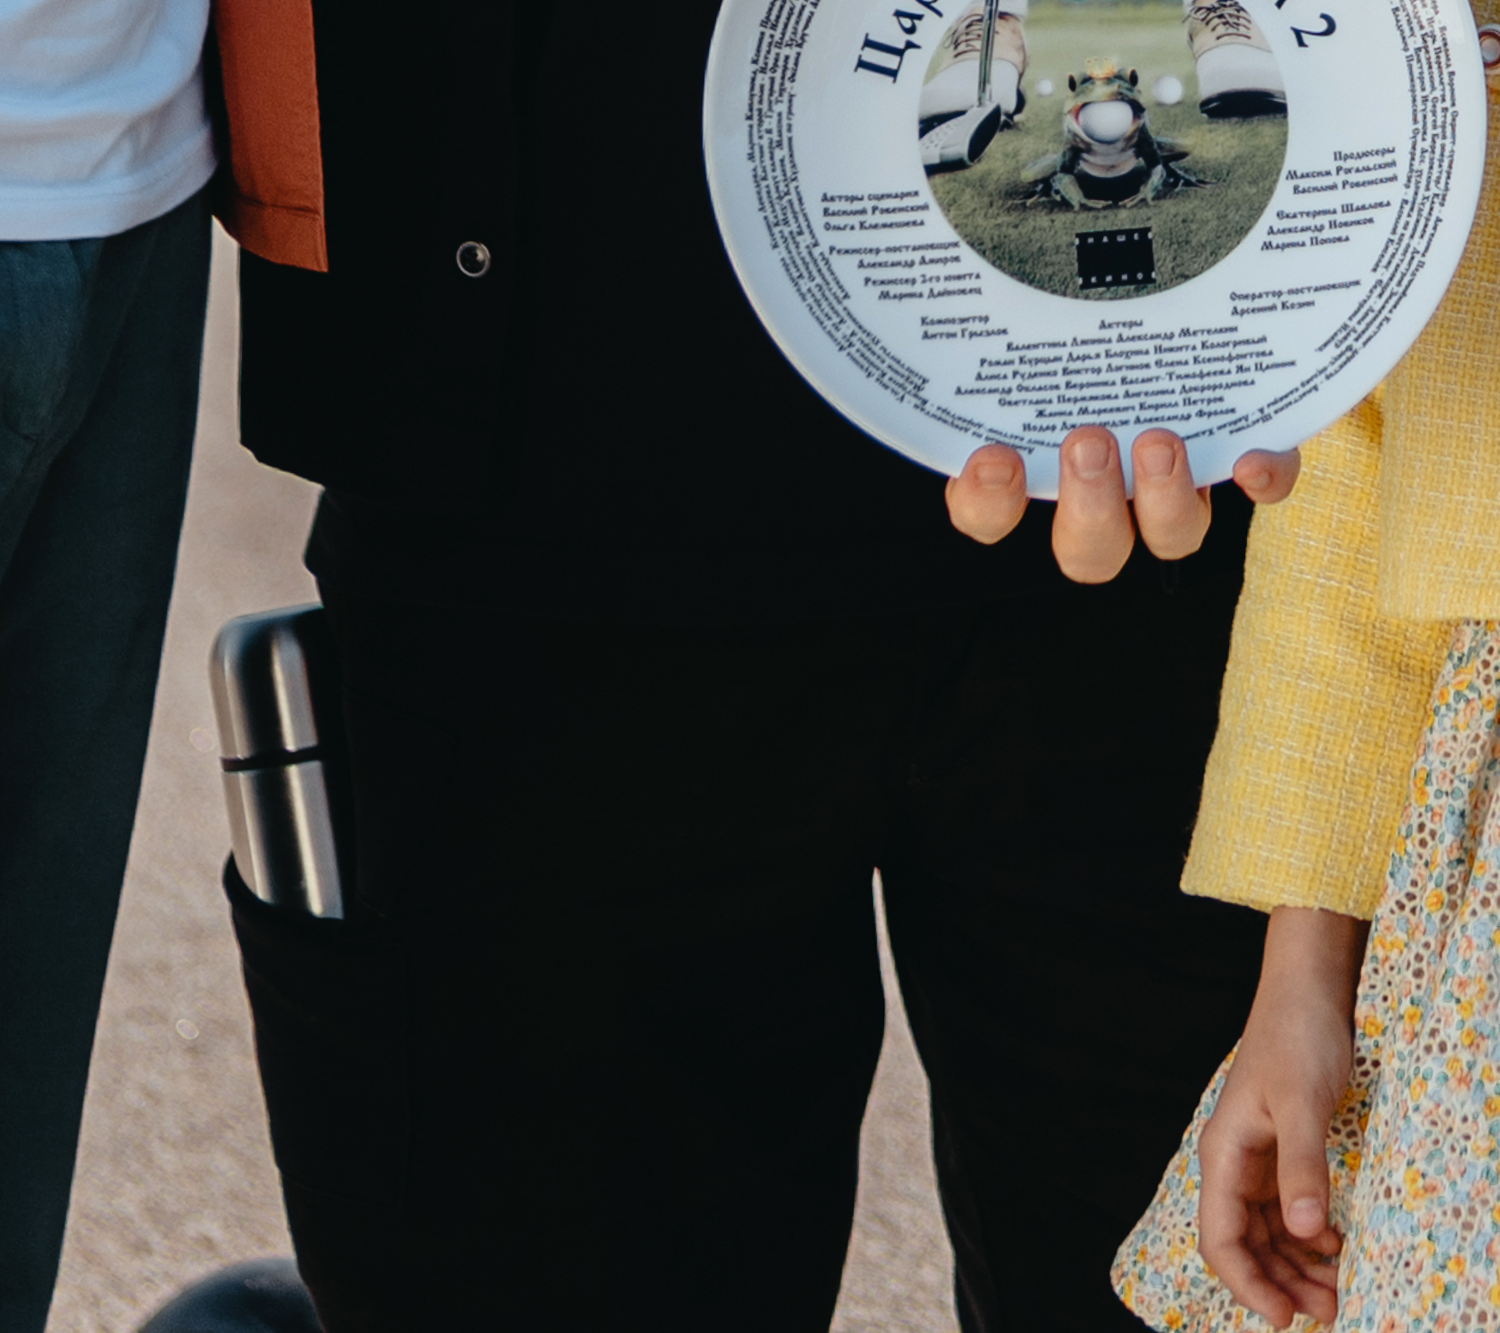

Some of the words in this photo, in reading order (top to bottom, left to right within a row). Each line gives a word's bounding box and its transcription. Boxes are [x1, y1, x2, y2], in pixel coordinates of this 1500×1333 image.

[1290, 13, 1337, 48] 2
[1334, 147, 1395, 162] Продюсеры
[1286, 170, 1332, 180] Максим
[1336, 160, 1396, 176] Рогальский
[1293, 182, 1338, 194] Василий
[1342, 174, 1398, 189] Ровенский
[821, 193, 864, 204] Авторы
[868, 191, 919, 201] сценария
[823, 207, 867, 217] Василий
[871, 203, 929, 215] Ровенский
[1276, 208, 1337, 220] Екатерина
[824, 222, 855, 231] Ольга
[1267, 224, 1325, 235] Александр
[1329, 217, 1374, 229] Новиков
[829, 242, 960, 256] Режиссер-постановщик
[1261, 241, 1306, 251] Марина
[1310, 236, 1350, 246] Попова
[857, 259, 915, 269] Александр
[919, 256, 961, 266] Амиров
[864, 277, 917, 286] Режиссер
[878, 291, 923, 301] Марина
[1230, 280, 1361, 302] Оператор-постановщик
[1231, 303, 1277, 317] Арсений
[1281, 301, 1315, 310] Козин
[921, 315, 989, 326] Композитор
[1099, 320, 1143, 330] Актеры
[922, 330, 957, 340] Антон
[1006, 341, 1067, 352] Валентина
[1116, 332, 1175, 343] Александр
[980, 358, 1015, 367] Роман
[1066, 352, 1101, 363] Дарья
[1154, 344, 1197, 354] Никита
[1201, 335, 1267, 350] Кологривый
[975, 372, 1008, 381] Алиса
[1012, 370, 1058, 381] Руденко
[1062, 367, 1102, 376] Виктор
[1106, 363, 1151, 373] Логинов
[1155, 359, 1189, 368] Елена
[1193, 350, 1273, 365] Ксенофонтова
[955, 386, 1013, 395] Александр
[1065, 380, 1116, 391] Вероника
[998, 398, 1053, 407] Светлана
[1057, 394, 1119, 404] Пермякова
[1123, 388, 1175, 399] Ангелина
[1036, 409, 1073, 418] Жанна
[1139, 401, 1179, 411] Кирилл
[1183, 396, 1224, 407] Петров
[1134, 413, 1192, 425] Александр
